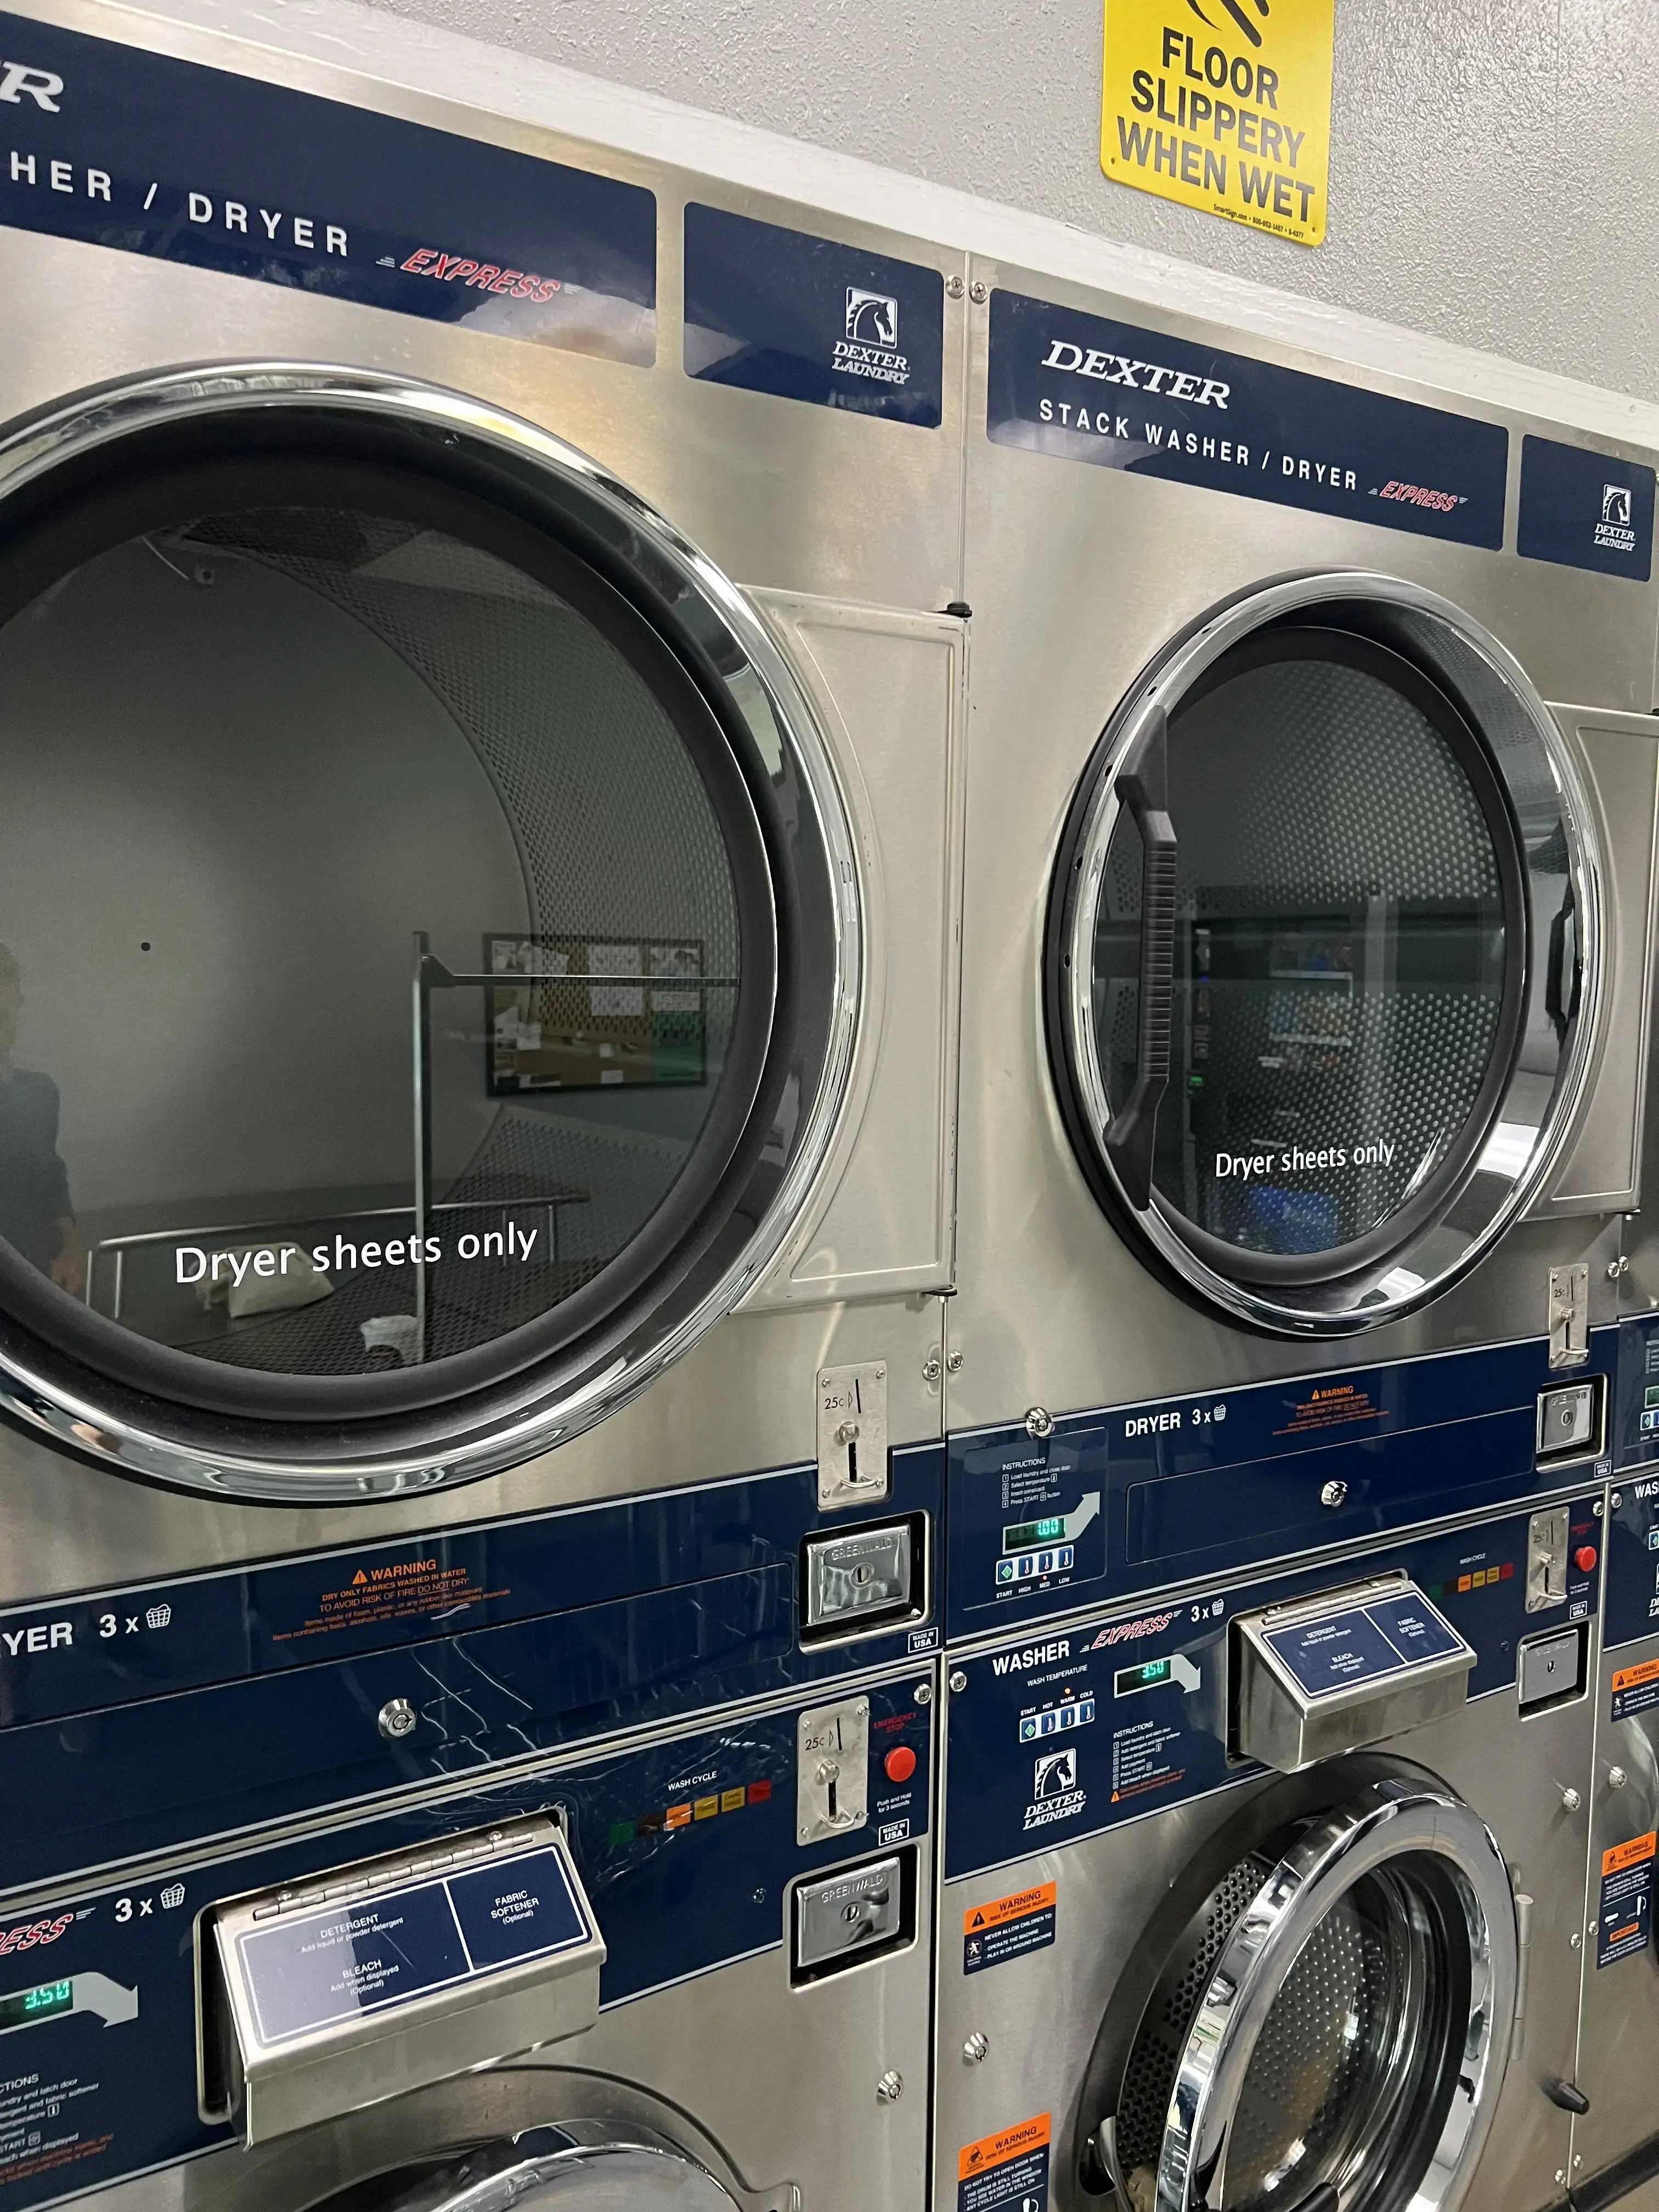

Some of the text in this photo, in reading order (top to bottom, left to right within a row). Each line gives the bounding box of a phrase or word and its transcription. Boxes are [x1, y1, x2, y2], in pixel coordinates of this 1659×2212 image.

[1162, 26, 1279, 110] FLOOR
[1130, 69, 1306, 168] SLIPPERY
[1117, 115, 1316, 223] WHEN WET
[10, 150, 111, 202] HER
[188, 192, 349, 257] DRYER
[400, 247, 561, 303] EXPRESS
[833, 341, 909, 371] DEXTER
[832, 357, 910, 385] LAUNDRY
[1041, 339, 1231, 410] DEXTER
[1040, 399, 1130, 439] STACK
[1144, 423, 1249, 467] WASHER
[1282, 455, 1357, 490] DRYER
[1379, 481, 1459, 512] EXPRESS
[1594, 523, 1635, 541] DEXTER
[1593, 534, 1636, 552] LAUNDRY
[1215, 1138, 1395, 1181] Dryer sheets only
[175, 1221, 538, 1288] Dryer sheets only
[1321, 1385, 1354, 1398] WARNING
[1125, 1408, 1211, 1438] DRYER 3 x
[1002, 1457, 1046, 1470] INSTRUCTIONS
[1635, 1481, 1659, 1499] WAS
[1472, 1553, 1486, 1561] CYCLE
[371, 1559, 436, 1581] WARNING
[322, 1593, 338, 1602] DRY
[340, 1588, 362, 1598] ONLY
[363, 1581, 396, 1594] FABRICS
[397, 1575, 430, 1587] WASHED
[441, 1568, 466, 1579] WATER
[996, 1590, 1013, 1599] START
[1018, 1585, 1031, 1594] HIGH
[319, 1604, 332, 1613] TO
[333, 1598, 360, 1611] AVOID
[362, 1593, 382, 1605] RISK
[384, 1591, 396, 1601] OF
[397, 1588, 416, 1598] FIRE
[417, 1584, 431, 1594] DO
[432, 1581, 450, 1591] NOT
[2, 1613, 139, 1656] YER 3 x
[912, 1632, 927, 1641] MADE
[992, 1605, 1210, 1676] WASHER EXPRESS 3 x
[1306, 1626, 1338, 1639] DETERGENT
[914, 1638, 932, 1649] USA
[1027, 1664, 1088, 1687] WASH TEMPERATURE
[1633, 1663, 1657, 1676] WARNING
[1042, 1701, 1053, 1709] HOT
[1060, 1695, 1075, 1705] WARM
[1080, 1690, 1093, 1699] COLD
[873, 1712, 917, 1729] EMERGENCY
[1020, 1706, 1036, 1717] START
[886, 1722, 905, 1734] STOP
[1113, 1720, 1154, 1739] INSTRUCTIONS
[668, 1770, 718, 1791] WASH CYCLE
[877, 1792, 912, 1807] Push and Hold
[890, 1799, 910, 1809] seconds
[1023, 1790, 1084, 1819] DEXTER
[1022, 1801, 1086, 1830] LAUNDRY
[883, 1825, 899, 1835] MADE
[884, 1829, 904, 1842] USA
[490, 1898, 539, 1918] SOFTENER
[495, 1890, 528, 1907] FABRIC
[999, 1891, 1041, 1912] WARNING
[115, 1898, 133, 1922] 3
[139, 1898, 153, 1917] x
[503, 1910, 534, 1925] (Optional)
[989, 1912, 1002, 1922] RISK
[1032, 1897, 1049, 1908] INJURY
[301, 1944, 315, 1954] Add
[317, 1938, 335, 1949] liquid
[345, 1928, 370, 1941] powder
[371, 1917, 404, 1932] detergent
[320, 1913, 379, 1939] DETERGENT
[984, 1930, 1002, 1941] NEVER
[1002, 1923, 1020, 1934] ALLOW
[1020, 1915, 1045, 1929] CHILDREN
[986, 1951, 1000, 1960] PLAY
[1013, 1938, 1032, 1950] AROUND
[1032, 1931, 1053, 1944] MACHINE
[987, 1939, 1009, 1951] OPERATE
[1018, 1928, 1040, 1941] MACHINE
[331, 1965, 399, 1993] Add when displayed
[342, 1959, 382, 1979] BLEACH
[350, 1979, 384, 1996] (Optional)
[995, 2126, 1037, 2150] WARNING
[972, 2179, 983, 2187] NOT
[983, 2174, 993, 2182] TRY
[1001, 2164, 1014, 2175] OPEN
[988, 2184, 1005, 2196] WATER
[966, 2203, 977, 2212] ANY
[977, 2196, 994, 2207] CYCLE
